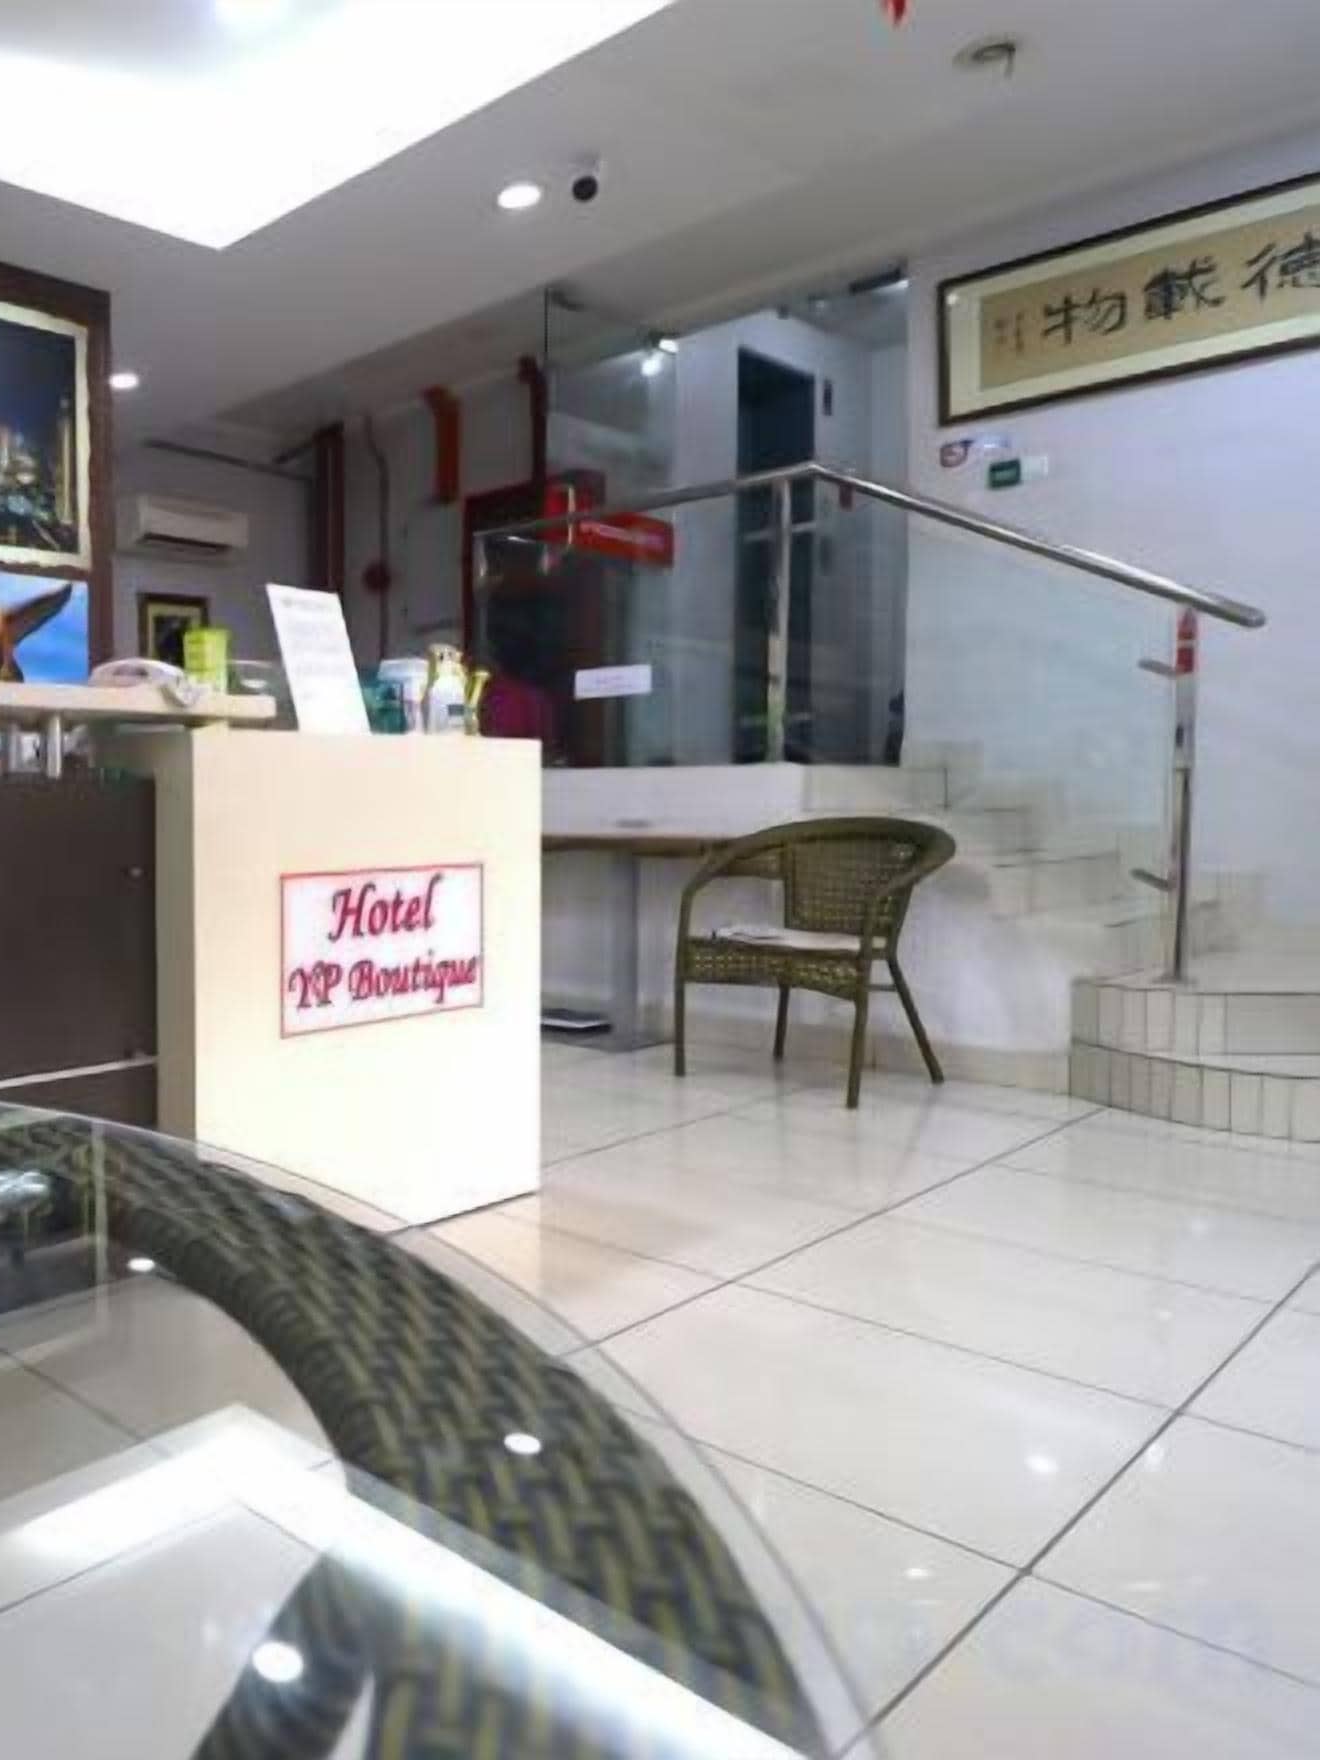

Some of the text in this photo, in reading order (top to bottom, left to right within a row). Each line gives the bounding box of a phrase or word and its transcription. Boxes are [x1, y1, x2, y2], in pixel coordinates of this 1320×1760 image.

[328, 872, 444, 943] Hotel
[288, 948, 480, 1009] YP Boutique
